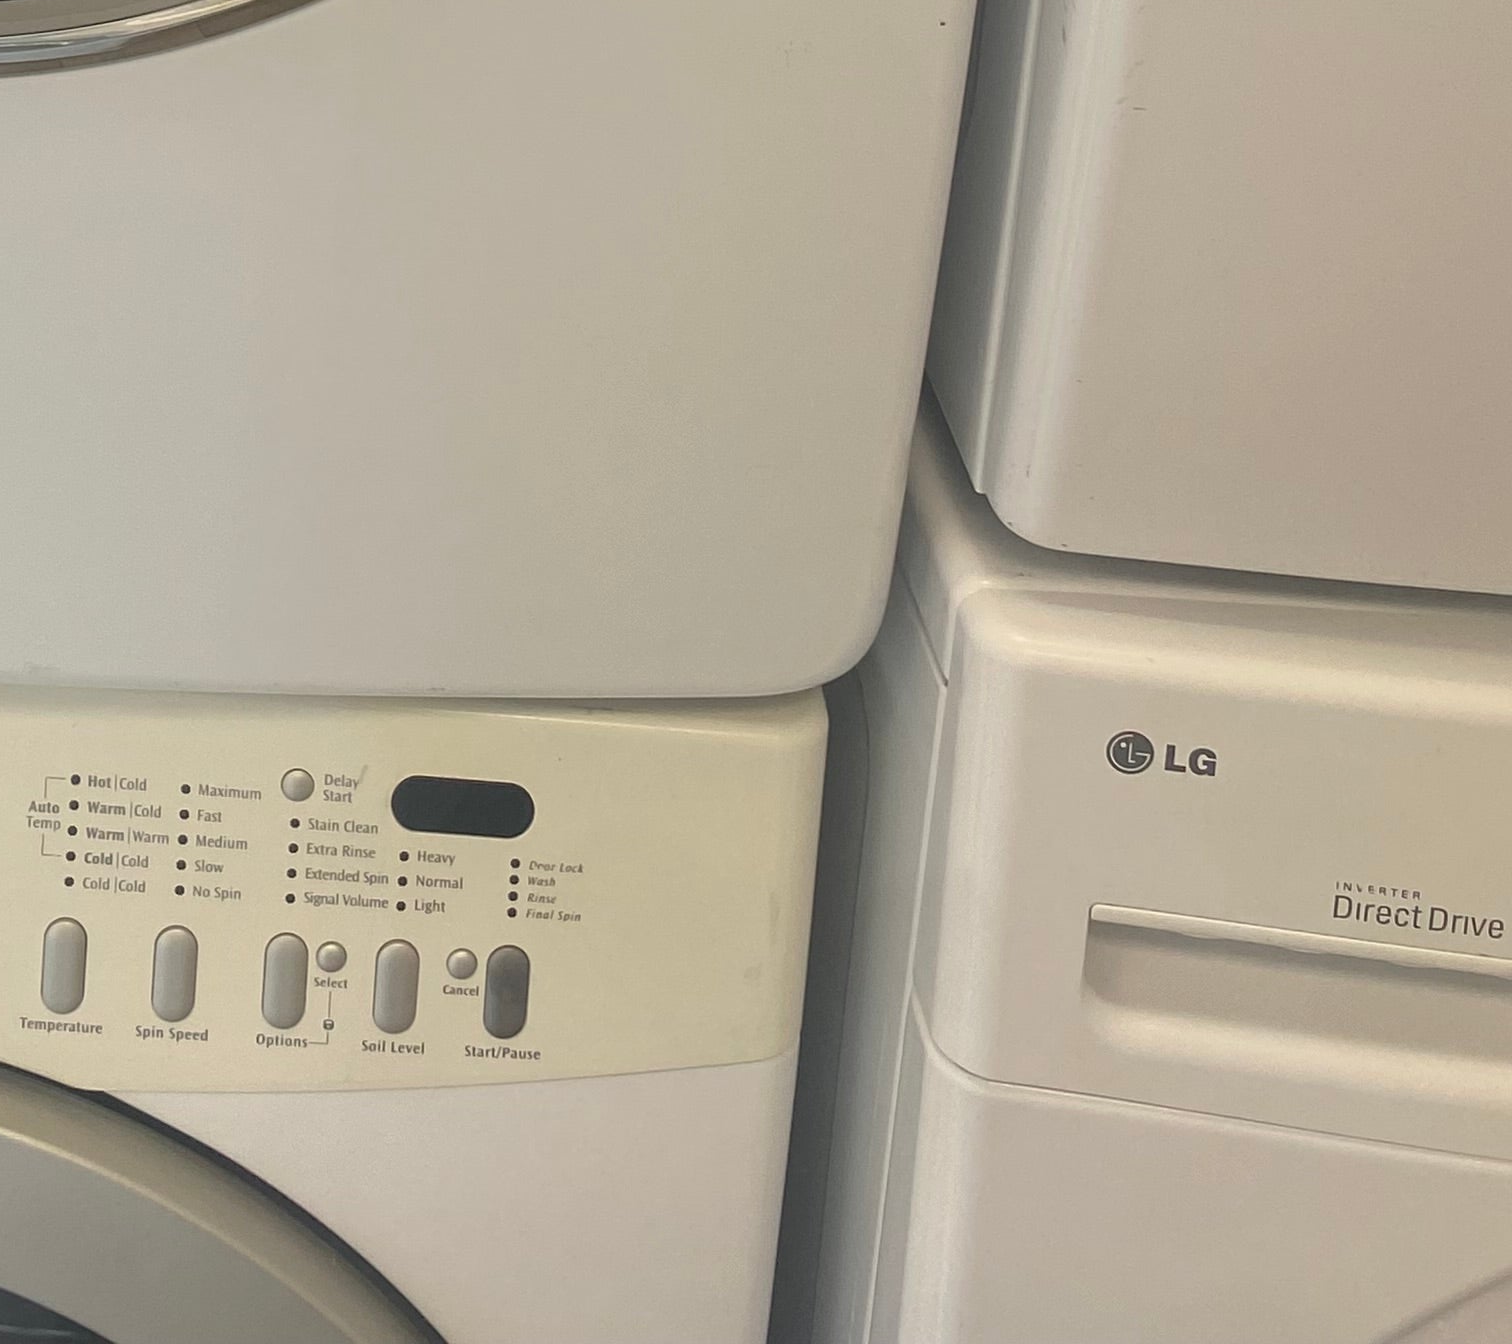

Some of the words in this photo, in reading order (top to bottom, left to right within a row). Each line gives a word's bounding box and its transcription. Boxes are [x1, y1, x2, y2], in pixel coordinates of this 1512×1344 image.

[1164, 744, 1217, 776] LG
[324, 773, 359, 790] Delay
[198, 785, 262, 801] Maximum
[323, 790, 352, 803] Start
[29, 801, 60, 814] Auto
[26, 816, 61, 832] Temp
[197, 810, 222, 823] Fast
[308, 819, 339, 832] Stain
[344, 820, 378, 834] Clean
[195, 835, 248, 850] Medium
[306, 843, 337, 856] Extra
[342, 845, 376, 858] Rinse
[417, 850, 455, 866] Heavy
[195, 861, 224, 874] Slow
[305, 868, 359, 883] Extended
[364, 871, 389, 885] Spin
[416, 876, 463, 890] Normal
[193, 886, 210, 898] No
[214, 887, 241, 901] Spin
[304, 893, 339, 908] Signal
[343, 894, 389, 908] Volume
[414, 900, 445, 914] Light
[526, 909, 554, 920] Final
[558, 910, 581, 922] Spin
[1333, 895, 1421, 930] Direct
[1429, 907, 1504, 939] Drive
[314, 977, 347, 989] Select
[443, 984, 479, 997] Cancel
[20, 1017, 103, 1036] Temperature
[136, 1026, 164, 1041] Spin
[169, 1027, 208, 1045] Speed
[256, 1033, 308, 1048] Options
[362, 1040, 386, 1053] Soil
[391, 1042, 425, 1055] Level
[465, 1045, 540, 1061] Start/Pause
